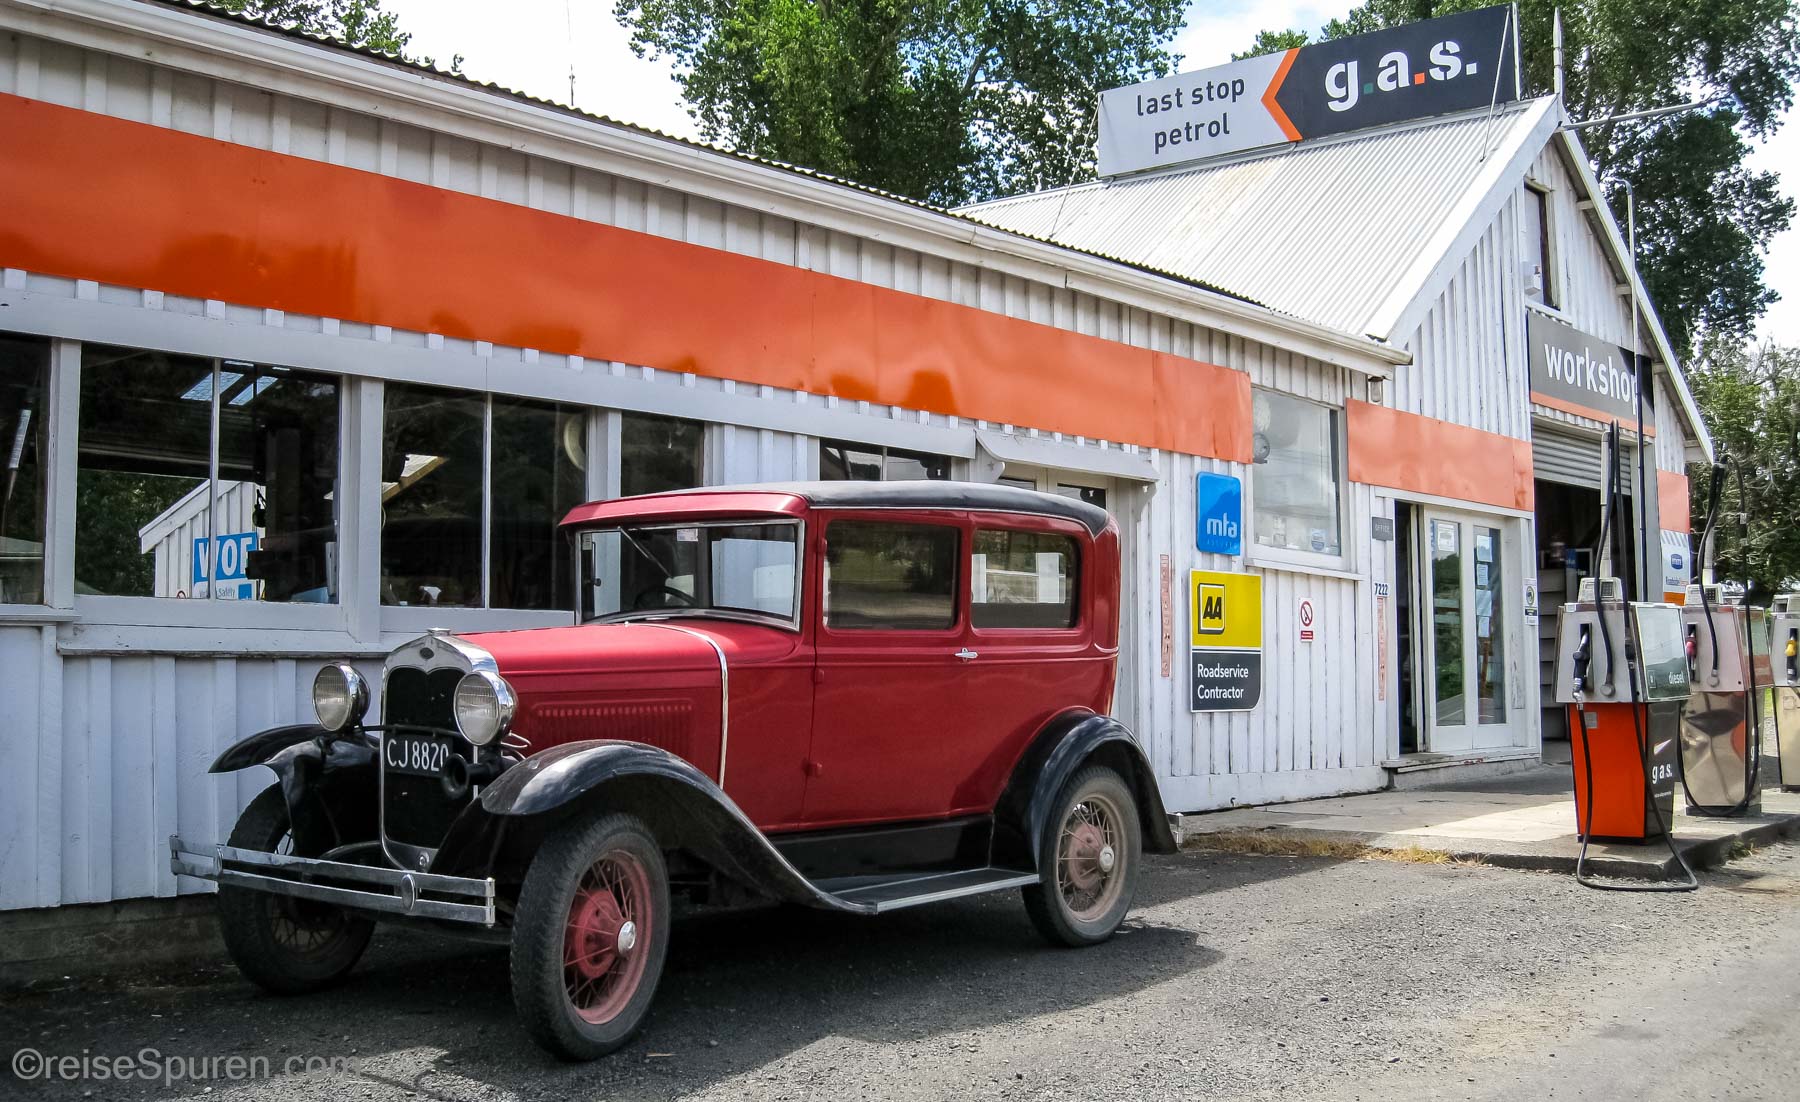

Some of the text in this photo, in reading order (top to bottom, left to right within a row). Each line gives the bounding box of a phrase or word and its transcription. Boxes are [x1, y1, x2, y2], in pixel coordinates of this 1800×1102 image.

[1324, 40, 1478, 112] g.a.s.
[1136, 77, 1246, 117] last stop
[1154, 112, 1231, 154] petrol
[1206, 512, 1238, 539] mta
[1374, 582, 1389, 596] 7222
[1203, 596, 1222, 620] AA
[1197, 663, 1249, 679] Roadservice
[1668, 671, 1685, 684] diesel
[1197, 684, 1244, 700] Contractor
